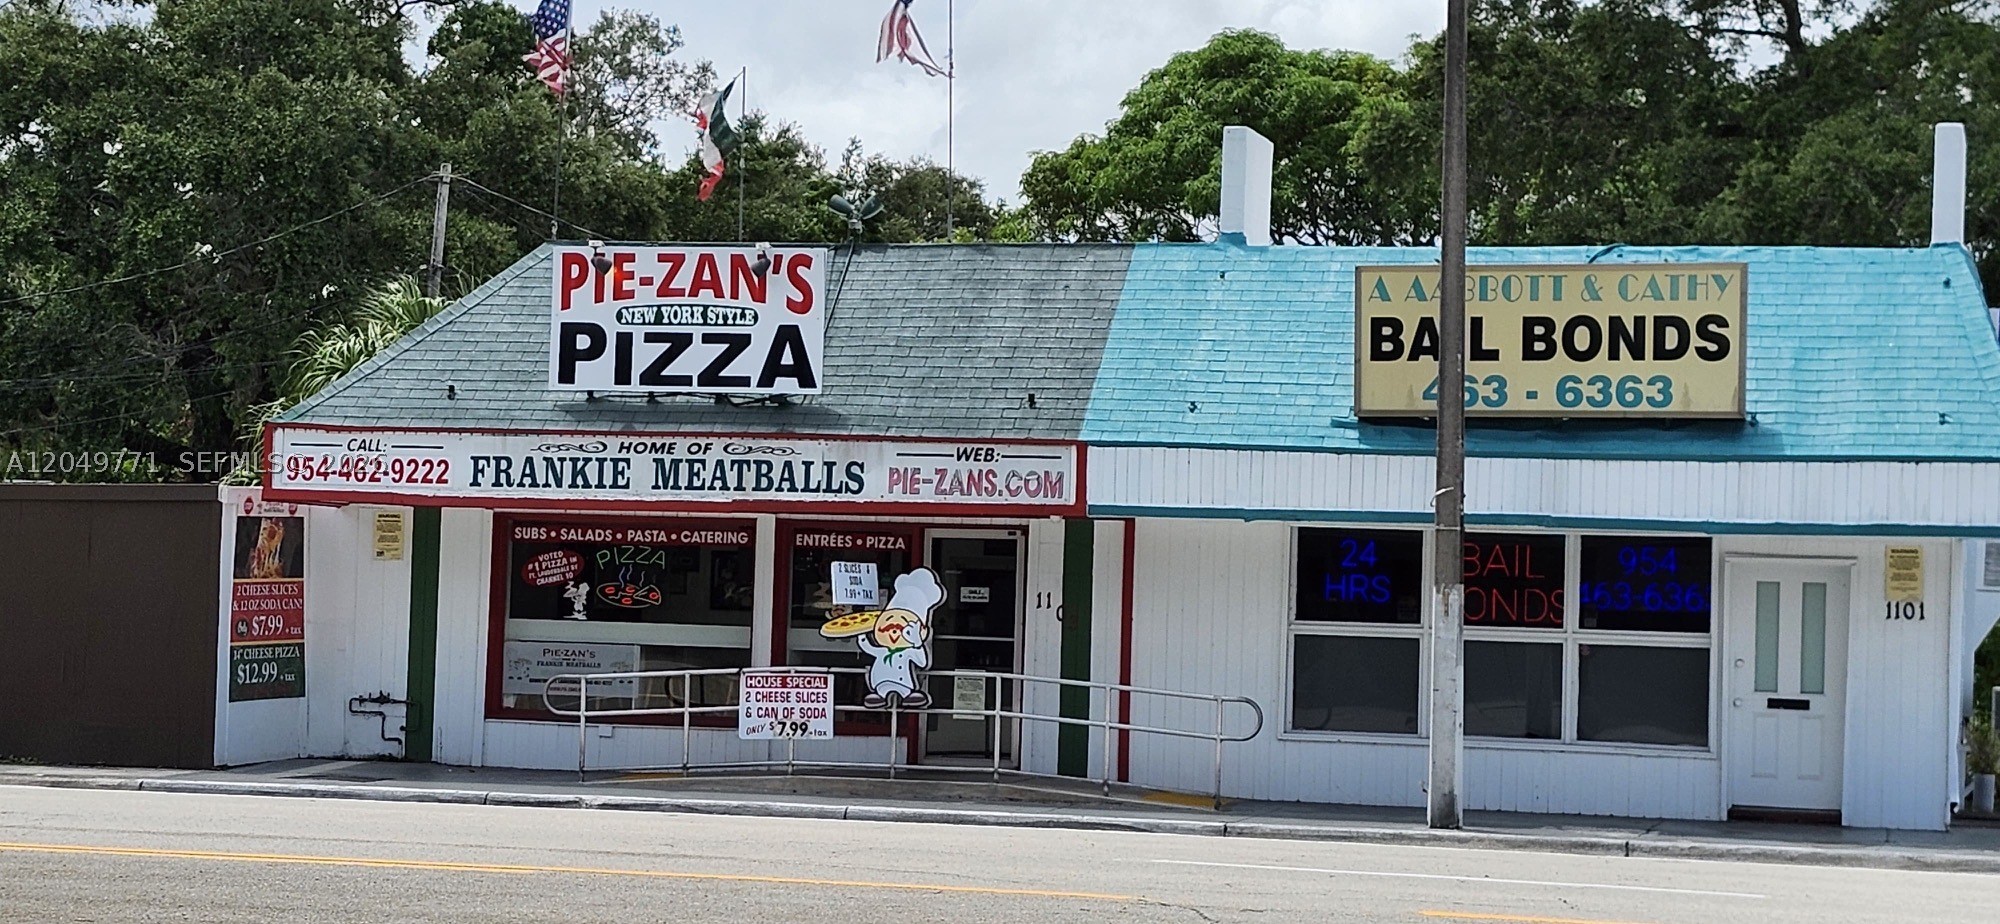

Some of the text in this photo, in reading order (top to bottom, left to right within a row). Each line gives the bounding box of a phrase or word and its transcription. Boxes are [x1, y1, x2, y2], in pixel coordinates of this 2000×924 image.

[560, 252, 814, 315] PIE-ZAN'S
[1368, 275, 1392, 302] A
[1581, 274, 1603, 303] &
[1618, 274, 1733, 302] CATHY
[620, 306, 755, 325] NEW YORK STYLE
[1370, 314, 1731, 362] BAL BONDS
[558, 322, 817, 388] PIZZA
[1555, 374, 1673, 408] 6363
[347, 438, 387, 452] CALL:
[618, 442, 713, 455] HOME OF
[956, 447, 999, 463] WEB:
[286, 456, 450, 484] 954-462-9222
[469, 456, 866, 494] FRANKIE MEATBALLS
[888, 467, 1064, 498] PIE-ZANS.COM
[514, 527, 749, 544] SUBS SALADS PASTA CATERING
[797, 532, 906, 550] ENTRÉES PIZZA
[538, 550, 563, 562] VOTED
[597, 545, 665, 569] PIZZA
[1339, 538, 1378, 569] 24
[1463, 542, 1545, 578] BAIL
[1618, 545, 1677, 576] 954
[528, 562, 539, 572] #1
[542, 557, 568, 570] PIZZA
[838, 563, 843, 573] 2
[565, 572, 574, 580] 10
[236, 583, 299, 596] 2 CHEESE SLICES
[1323, 572, 1392, 604] HRS
[233, 600, 239, 611] &
[241, 600, 248, 611] 12
[249, 599, 259, 610] OZ
[260, 599, 281, 610] SODA
[1886, 601, 1925, 620] 1101
[252, 614, 283, 636] $7.99
[244, 647, 274, 659] CHEESE
[275, 646, 300, 658] PIZZA
[237, 661, 278, 685] $12.99
[747, 677, 827, 688] HOUSE SPECIAL
[745, 691, 828, 703] 2 CHEESE SLICES
[745, 706, 827, 719] & CAN OF SODA
[746, 723, 766, 735] ONLY
